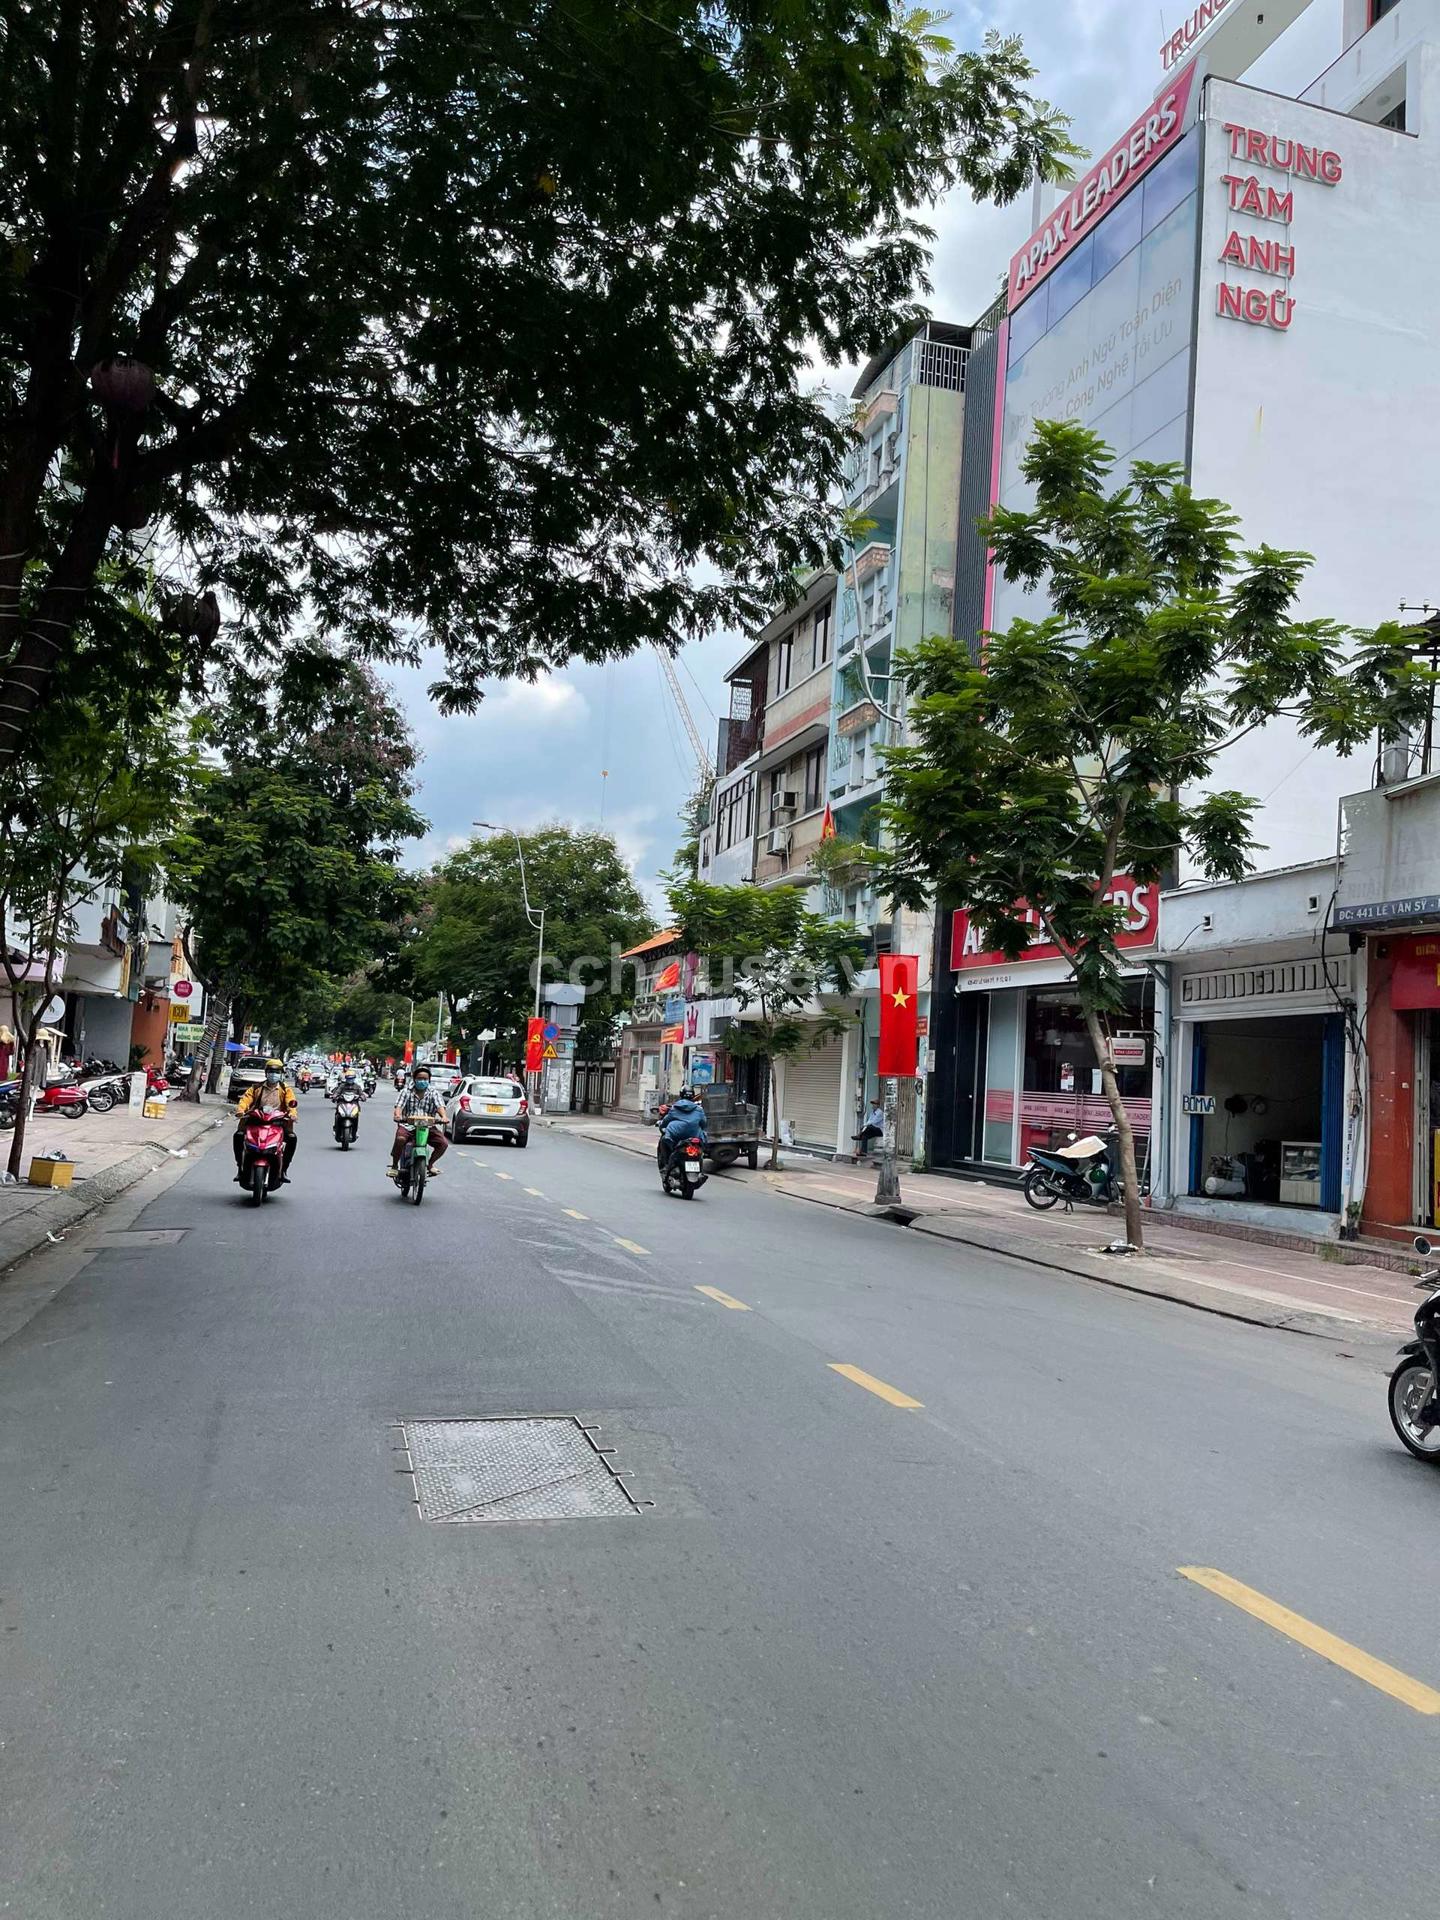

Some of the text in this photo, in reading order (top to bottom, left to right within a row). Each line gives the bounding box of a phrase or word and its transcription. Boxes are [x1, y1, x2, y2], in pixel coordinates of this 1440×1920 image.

[1222, 122, 1343, 184] TRUNG
[1016, 94, 1177, 289] APAX LEADERS
[1222, 174, 1294, 224] TÂM
[1219, 230, 1295, 279] ANH
[1218, 281, 1296, 329] NGỮ
[1067, 357, 1089, 389] Anh
[1356, 907, 1373, 918] 441
